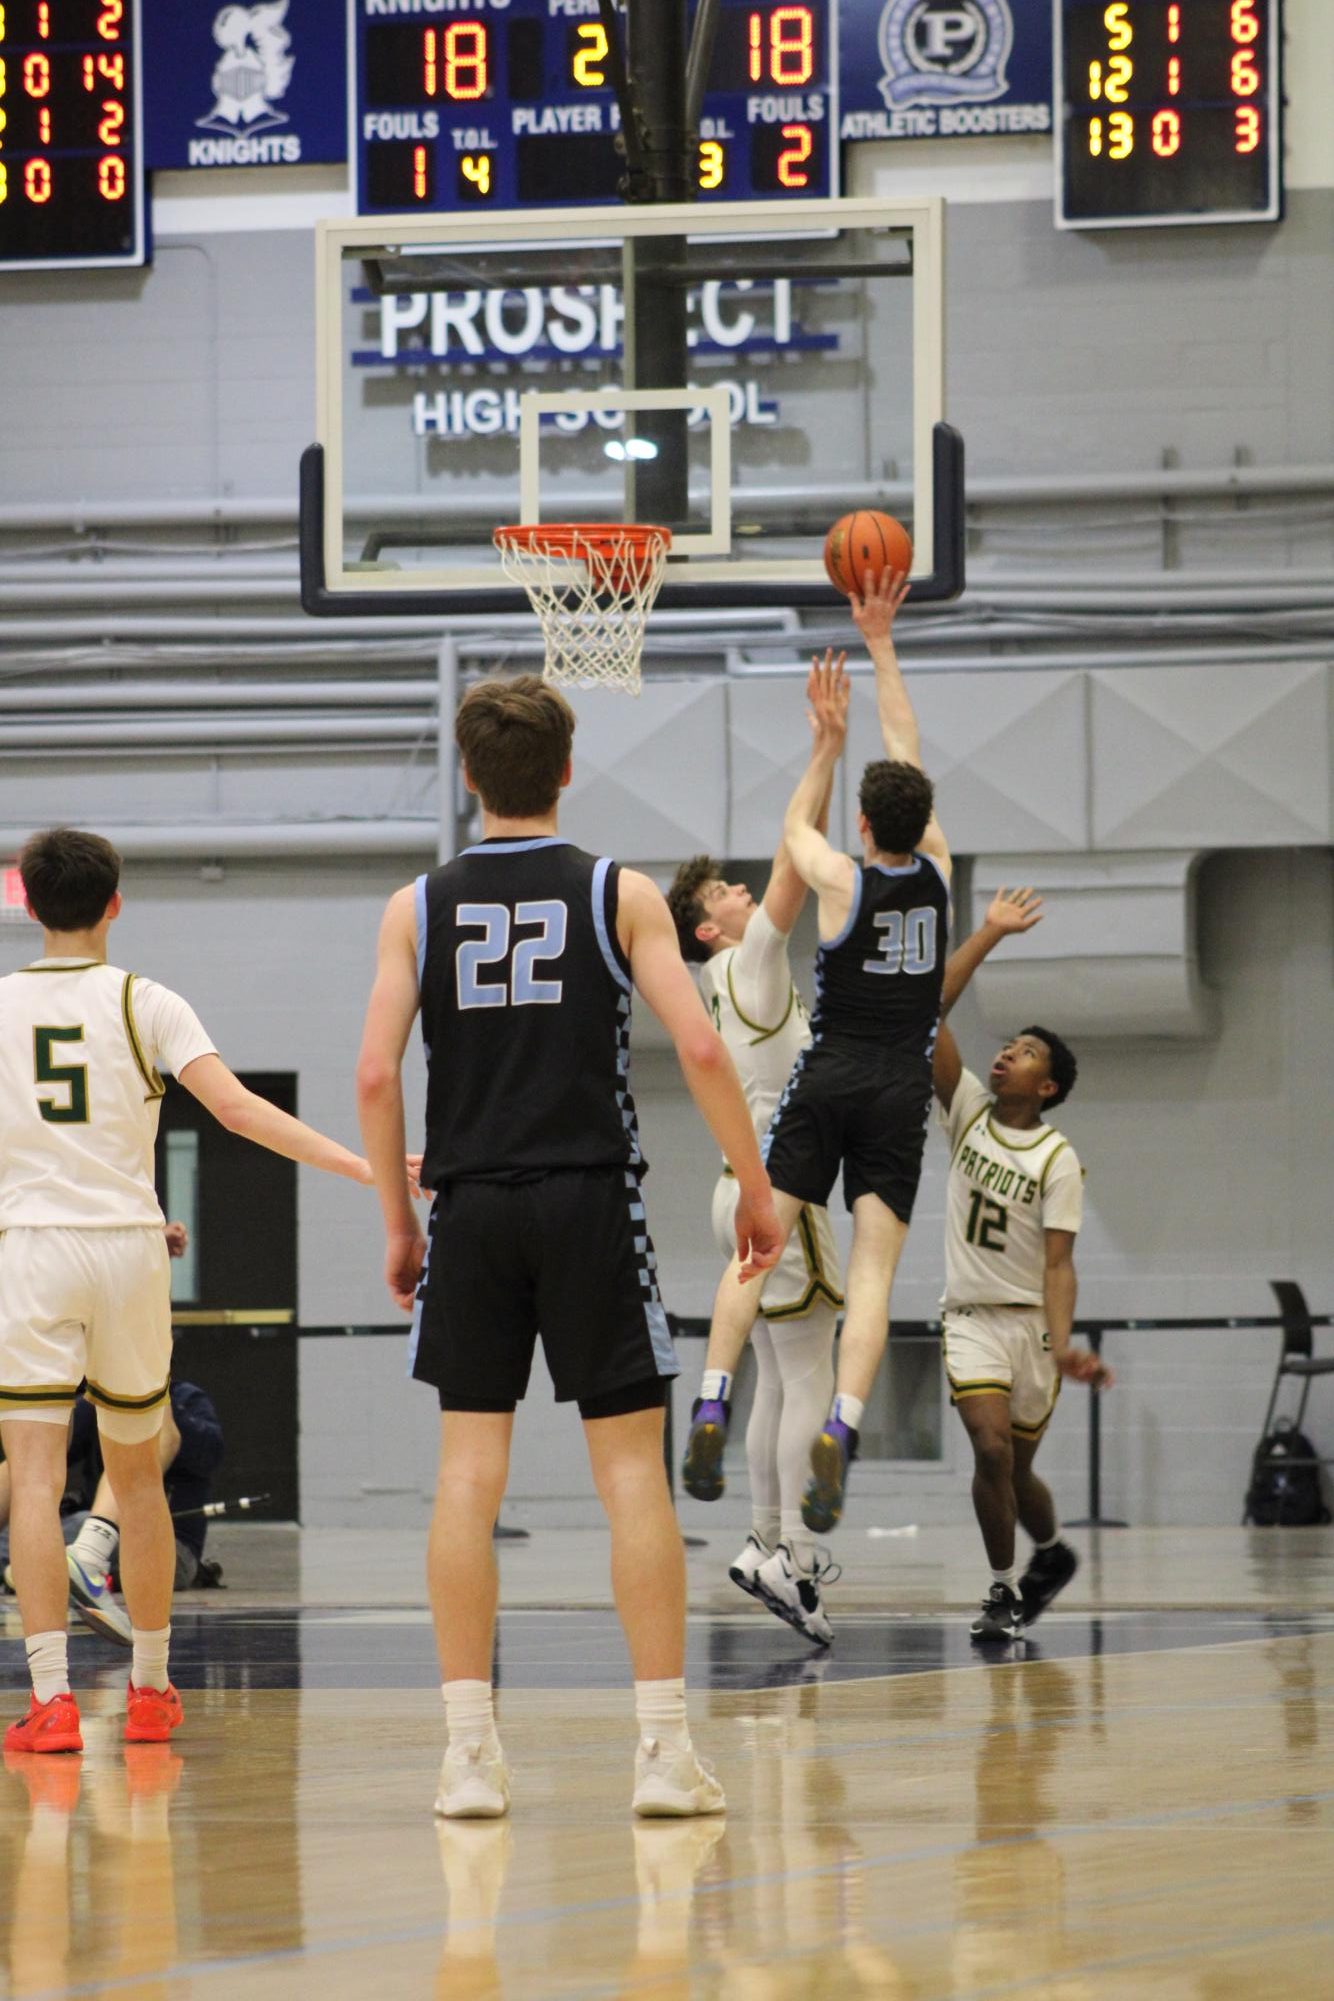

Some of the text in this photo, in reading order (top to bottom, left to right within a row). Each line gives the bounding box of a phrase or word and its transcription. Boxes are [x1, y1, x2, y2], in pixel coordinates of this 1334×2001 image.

[38, 1, 49, 39] 1
[97, 0, 123, 40] 2
[919, 10, 977, 57] P
[1104, 0, 1259, 50] 5 1 6
[424, 22, 487, 99] 18
[573, 23, 609, 86] 2
[749, 7, 812, 85] 18
[24, 53, 50, 98] 0
[83, 54, 124, 92] 14
[1089, 49, 1260, 103] 12 1 6
[39, 107, 50, 144] 1
[98, 100, 124, 146] 2
[364, 111, 440, 140] FOULS
[512, 103, 601, 135] PLAYER
[747, 94, 824, 123] FOULS
[841, 103, 1050, 138] ATHLETIC BOOSTERS
[1089, 106, 1259, 160] 13 0 3
[188, 135, 301, 165] KNIGHTS
[414, 145, 427, 199] 1
[461, 155, 490, 194] 4
[699, 141, 723, 189] 3
[777, 124, 812, 187] 2
[25, 157, 51, 203] 0
[99, 155, 125, 200] 0
[456, 899, 567, 1010] 22
[862, 906, 938, 975] 30
[33, 1023, 90, 1124] 5
[957, 1144, 1038, 1204] PATRIOTS
[966, 1189, 1008, 1252] 12
